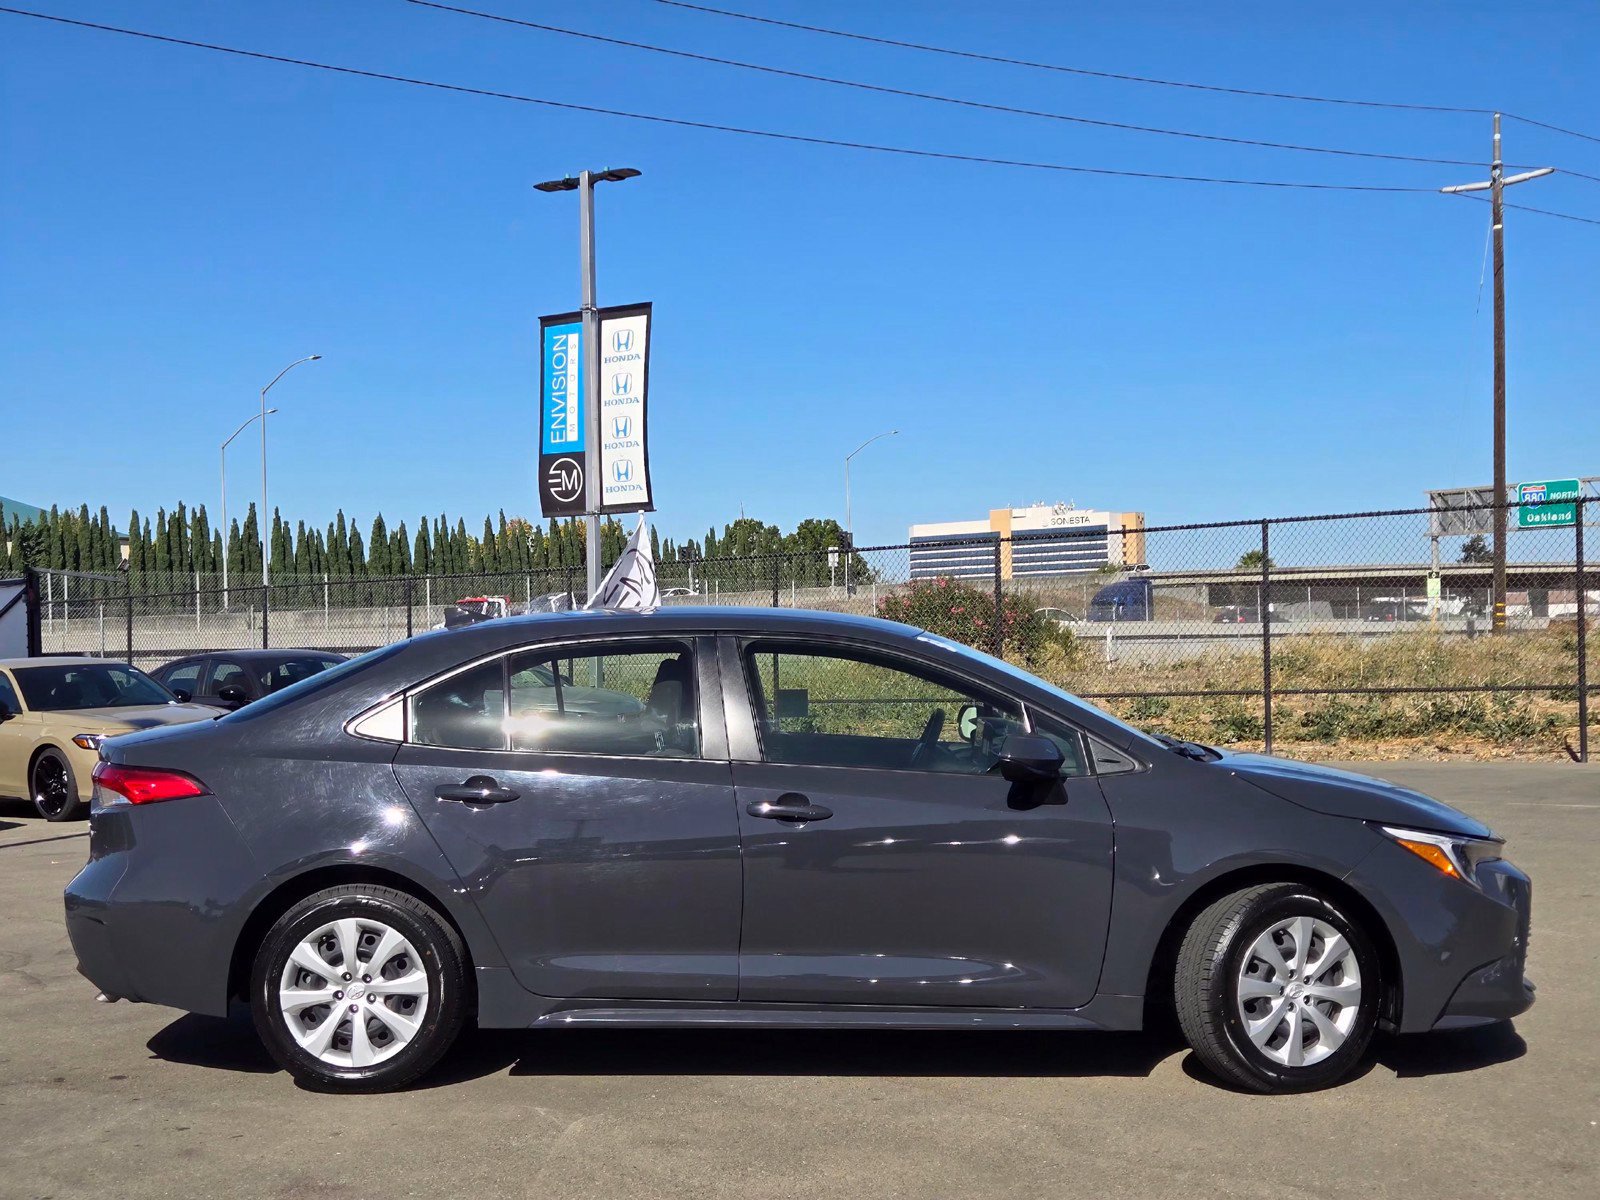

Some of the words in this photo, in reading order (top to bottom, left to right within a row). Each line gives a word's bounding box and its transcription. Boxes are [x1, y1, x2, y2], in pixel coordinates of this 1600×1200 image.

[604, 353, 641, 364] HONDA
[550, 334, 567, 444] ENVISION
[569, 343, 577, 432] MOTORS
[604, 396, 640, 407] HONDA
[604, 440, 640, 450] HONDA
[605, 484, 643, 494] HONDA
[1524, 492, 1545, 502] 880
[1550, 491, 1578, 500] NORTH
[1050, 516, 1091, 526] SONESTA
[1527, 511, 1572, 522] Oakland
